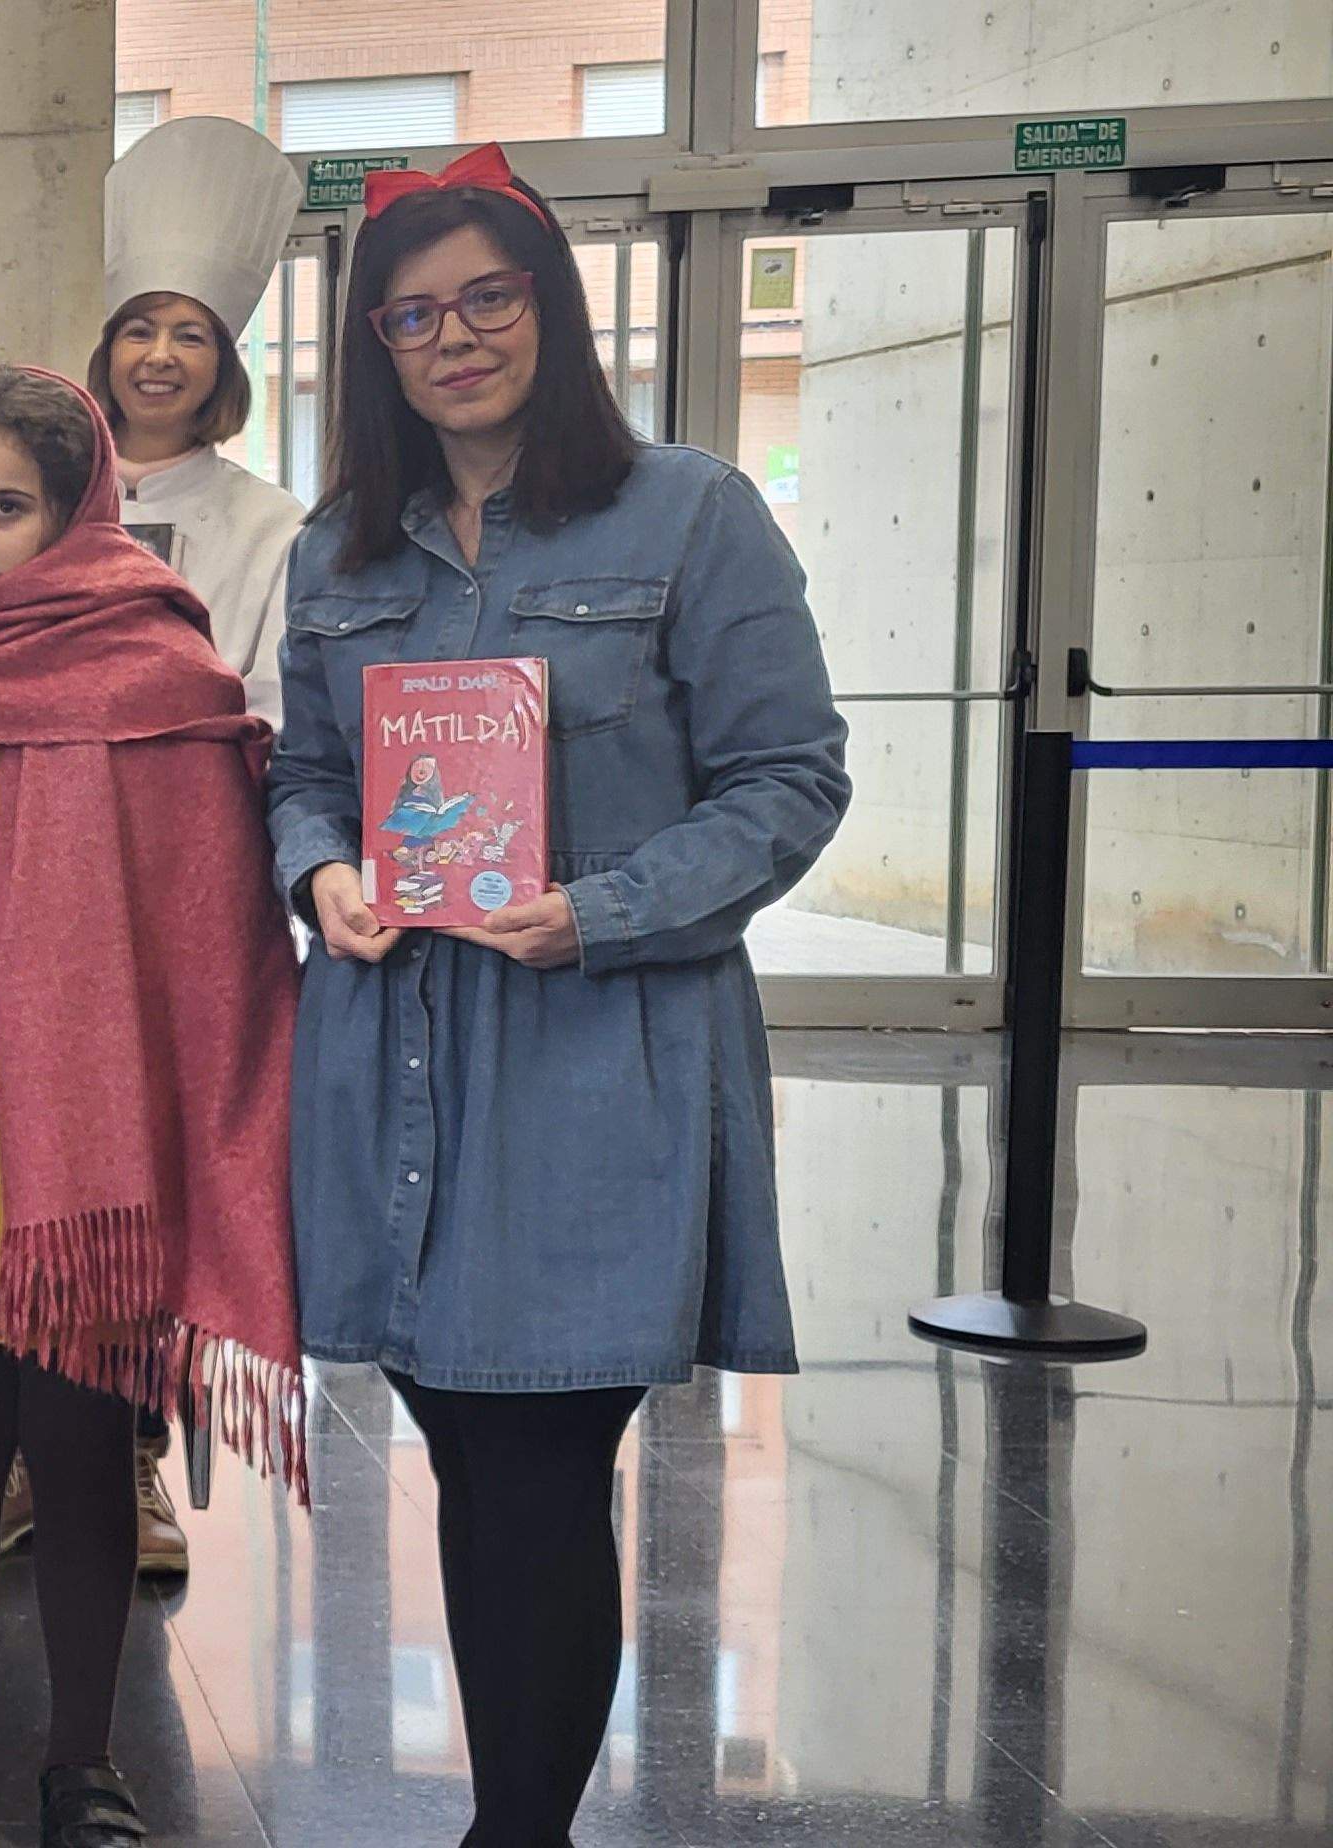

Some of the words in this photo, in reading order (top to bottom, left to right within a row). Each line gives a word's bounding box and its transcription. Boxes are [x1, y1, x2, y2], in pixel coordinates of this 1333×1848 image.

[1022, 124, 1078, 145] SALIDA
[1098, 122, 1119, 141] DE
[1017, 144, 1122, 168] EMERGENCIA
[313, 159, 364, 181] SALIDA
[401, 675, 452, 693] ROALD
[380, 709, 523, 748] MATILDA
